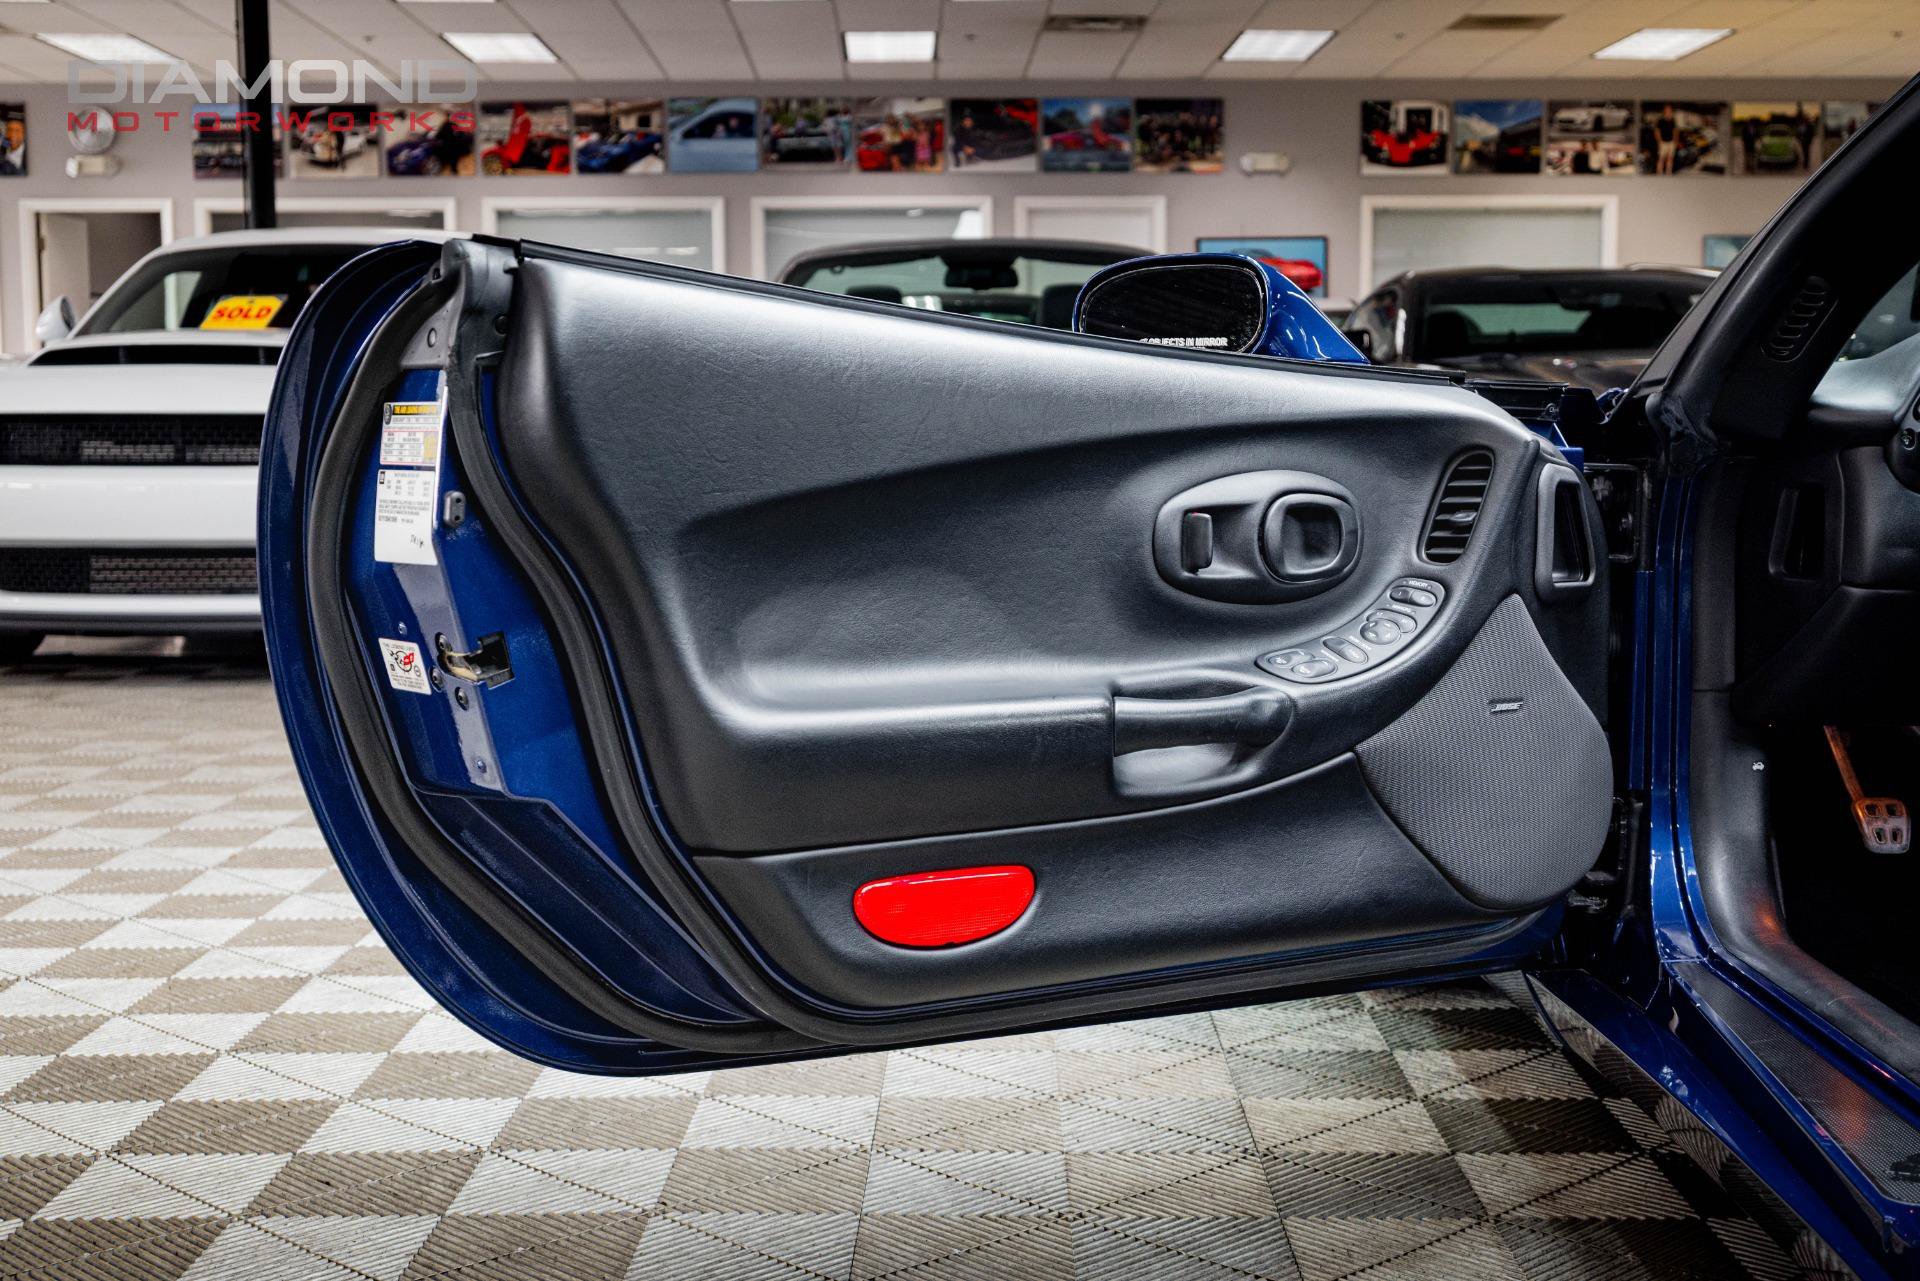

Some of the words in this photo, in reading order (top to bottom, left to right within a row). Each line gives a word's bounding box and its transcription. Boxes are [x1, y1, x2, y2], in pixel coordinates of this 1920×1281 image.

[212, 305, 273, 320] SOLD
[1185, 337, 1195, 346] IN
[1195, 337, 1228, 346] MIRROR
[1491, 702, 1523, 711] BOSE
